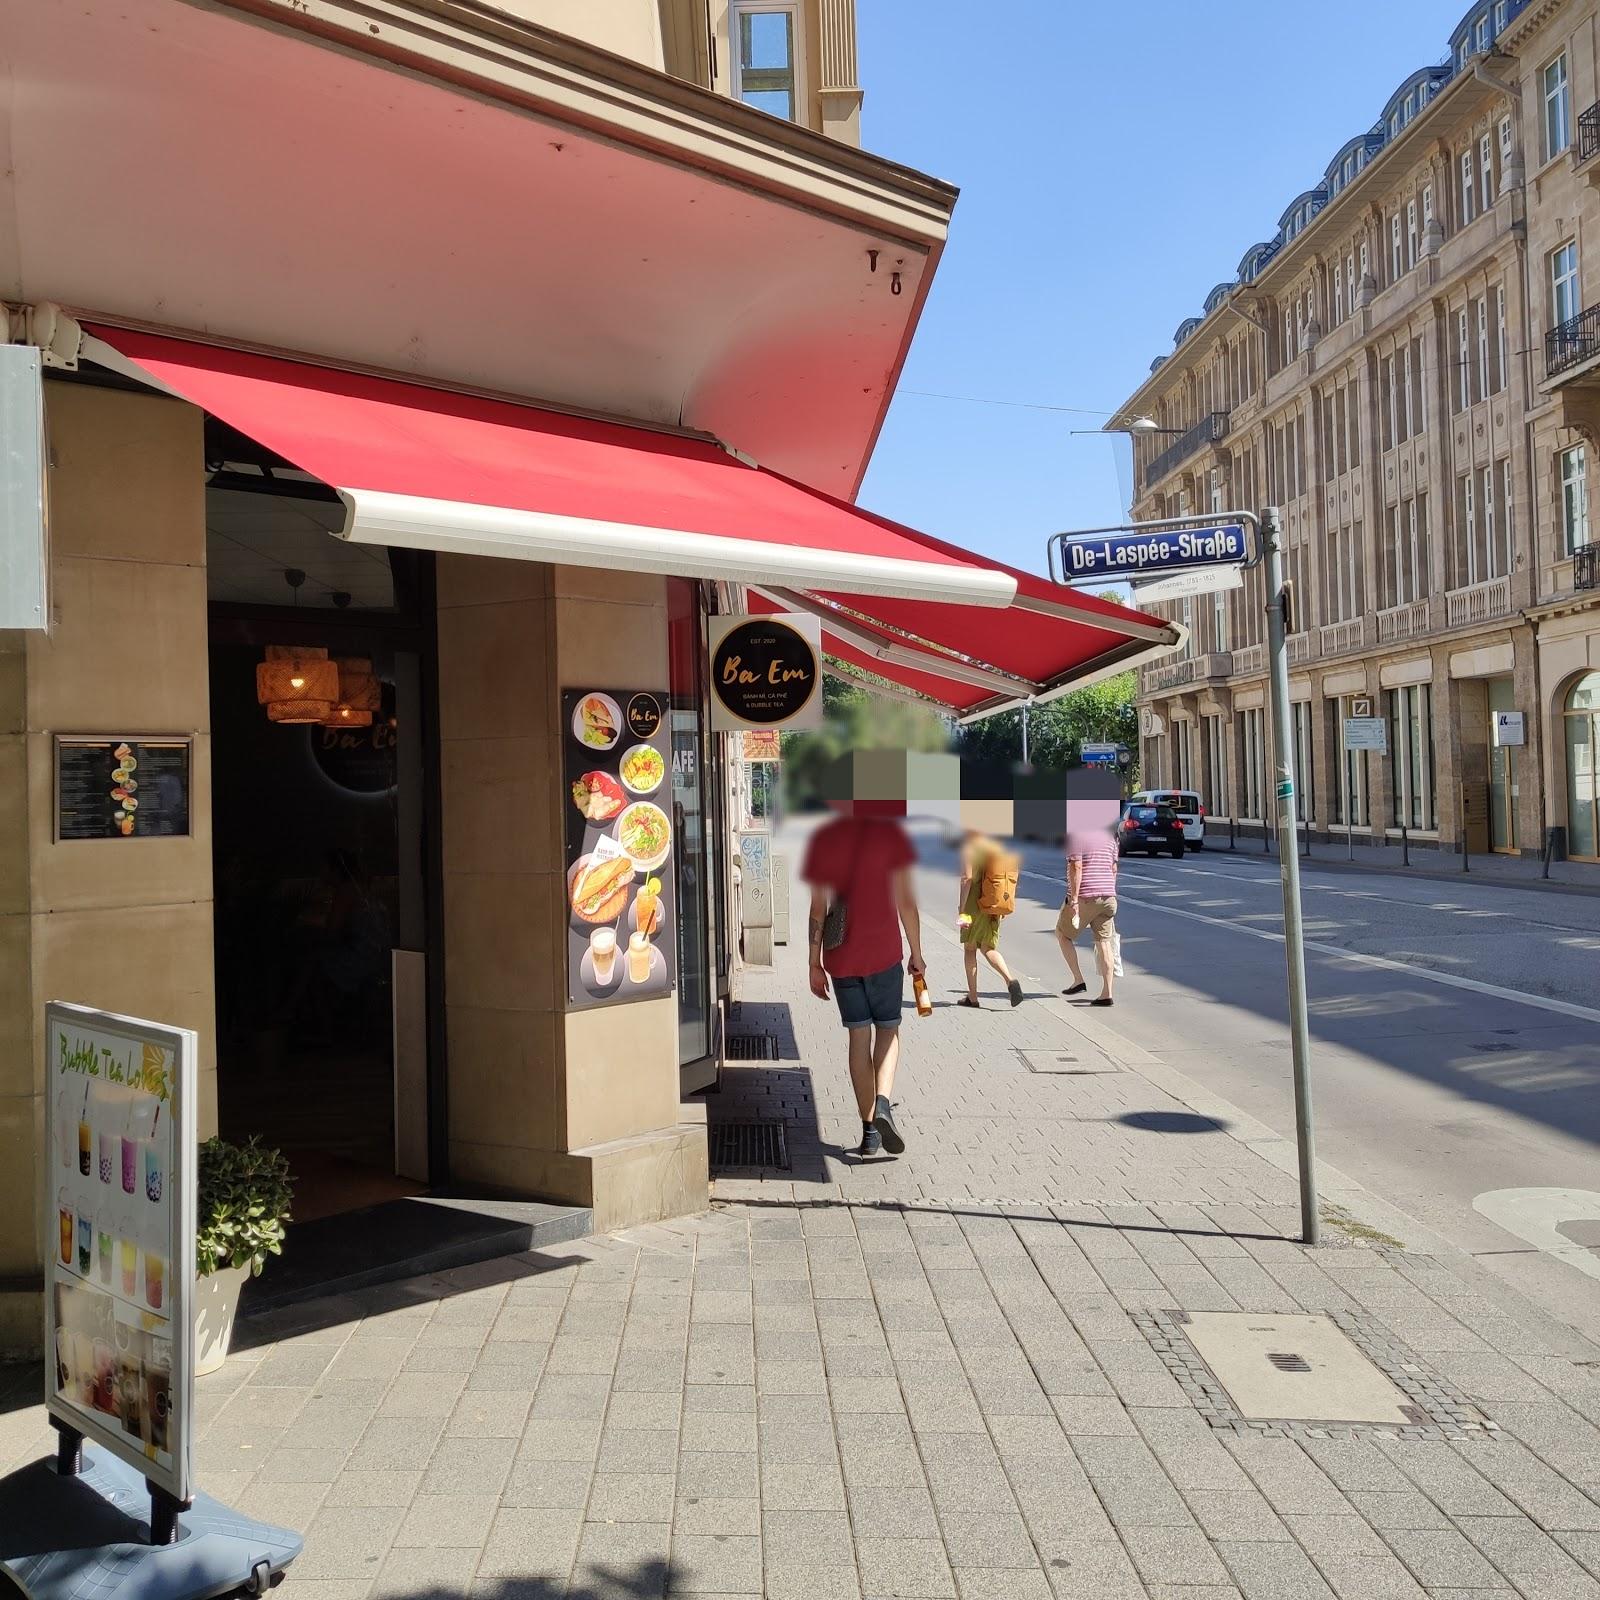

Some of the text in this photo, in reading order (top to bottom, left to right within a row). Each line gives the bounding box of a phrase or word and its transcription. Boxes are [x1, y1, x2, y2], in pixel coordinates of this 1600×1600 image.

[1072, 530, 1238, 570] De-Laspée-Straße
[722, 655, 810, 685] Ba Em
[631, 708, 644, 721] Ba
[671, 750, 694, 773] AFE
[60, 1032, 99, 1075] Bubble
[101, 1048, 123, 1082] Tea
